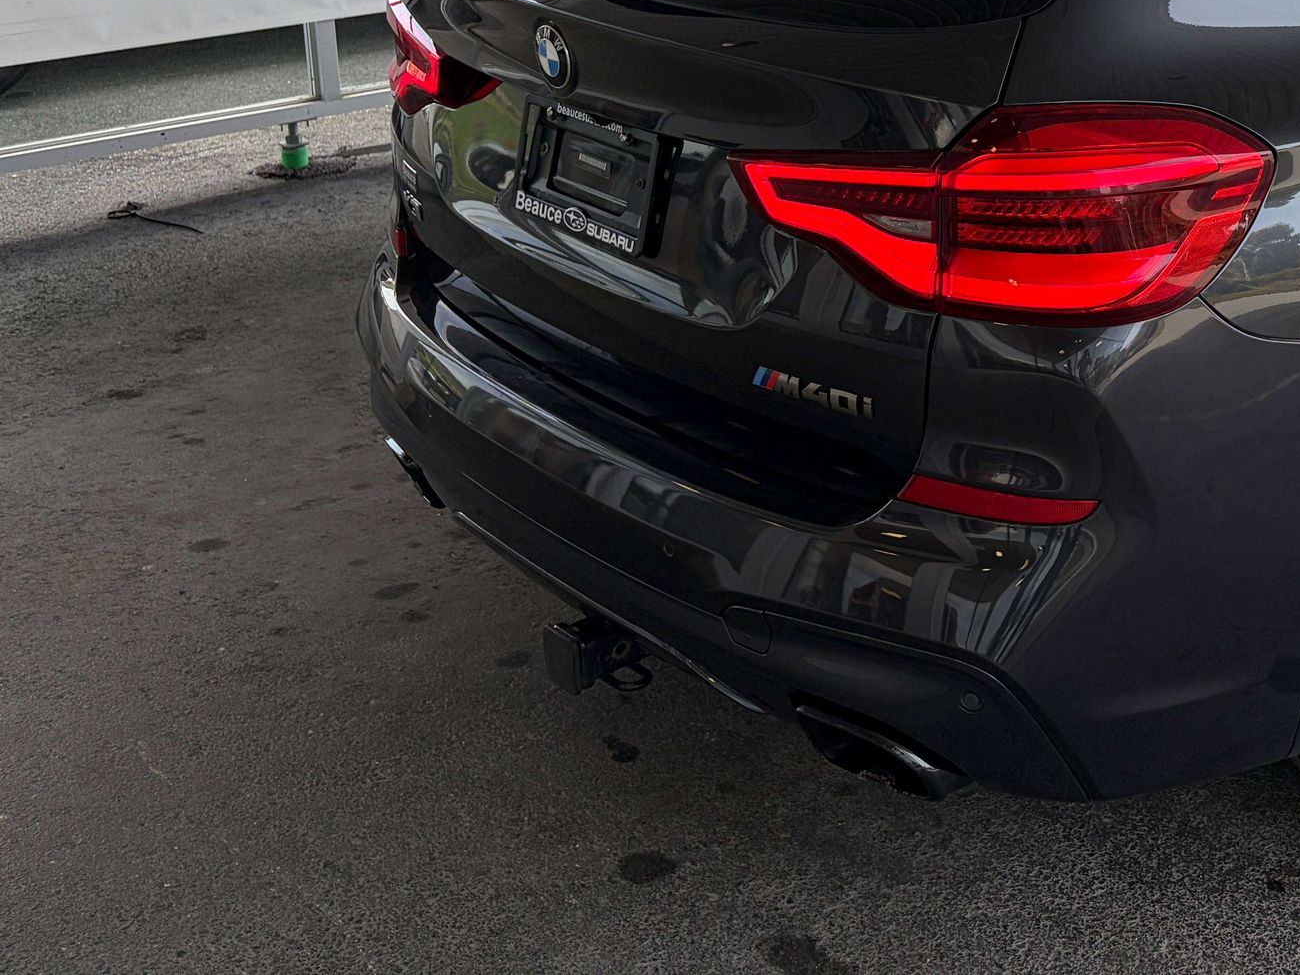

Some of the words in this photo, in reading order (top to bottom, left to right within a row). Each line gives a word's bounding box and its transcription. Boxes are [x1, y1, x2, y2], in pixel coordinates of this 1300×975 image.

[535, 27, 564, 52] BMW
[557, 103, 623, 134] beaucesu.com
[515, 190, 562, 224] Beauce
[586, 222, 635, 253] SUBARU
[773, 372, 873, 420] M40i
